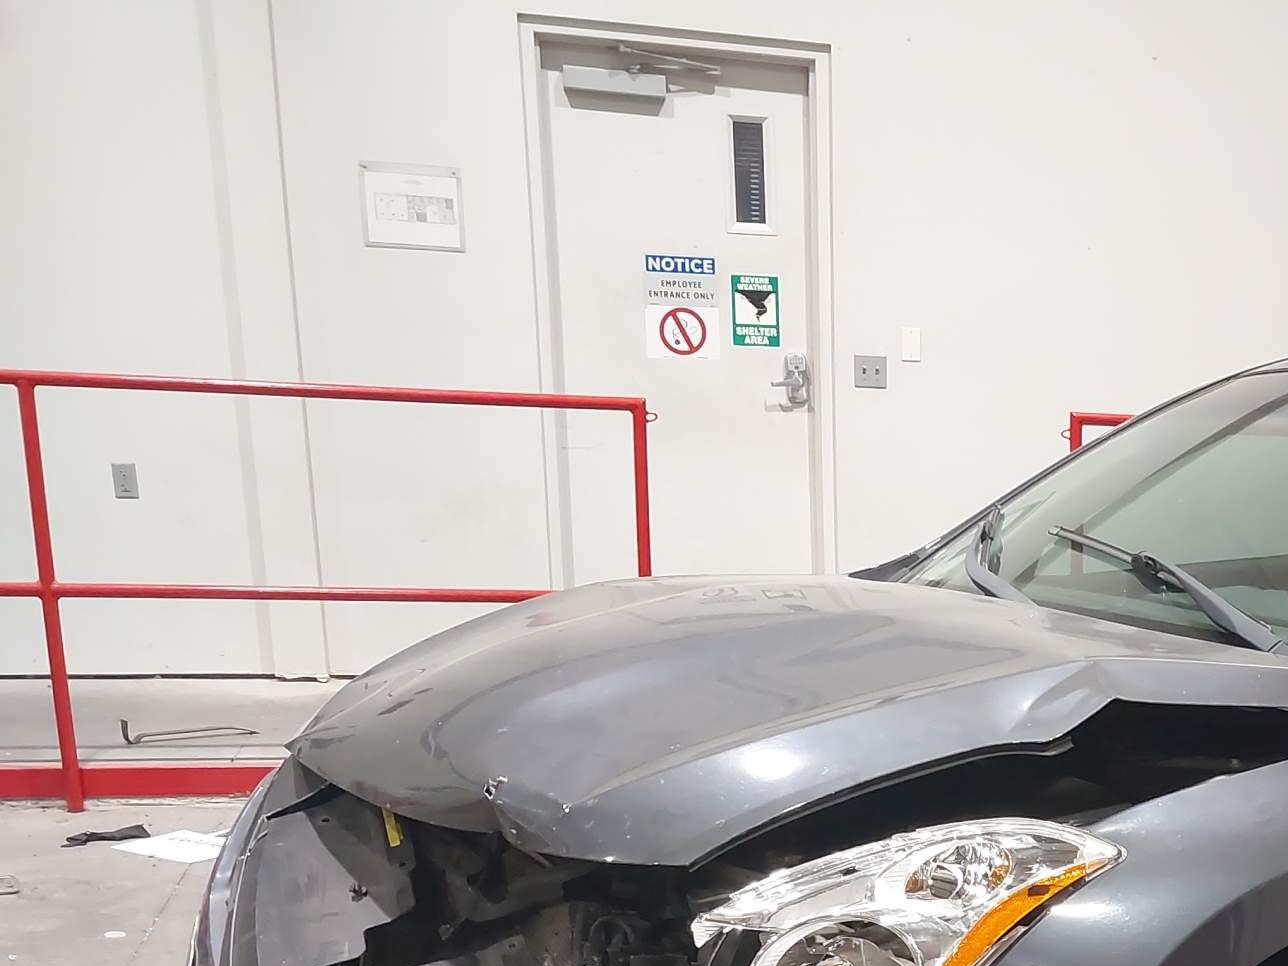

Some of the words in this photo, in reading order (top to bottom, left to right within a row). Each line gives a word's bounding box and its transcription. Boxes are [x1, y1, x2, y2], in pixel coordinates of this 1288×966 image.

[646, 256, 714, 273] NOTICE
[660, 279, 702, 289] EMPLOYEE
[739, 276, 770, 284] SEVERE
[736, 283, 773, 291] WEATHER
[648, 290, 691, 299] ENTRANCE
[693, 292, 715, 301] ONLY
[735, 326, 777, 336] SHELTER
[744, 336, 770, 345] AREA
